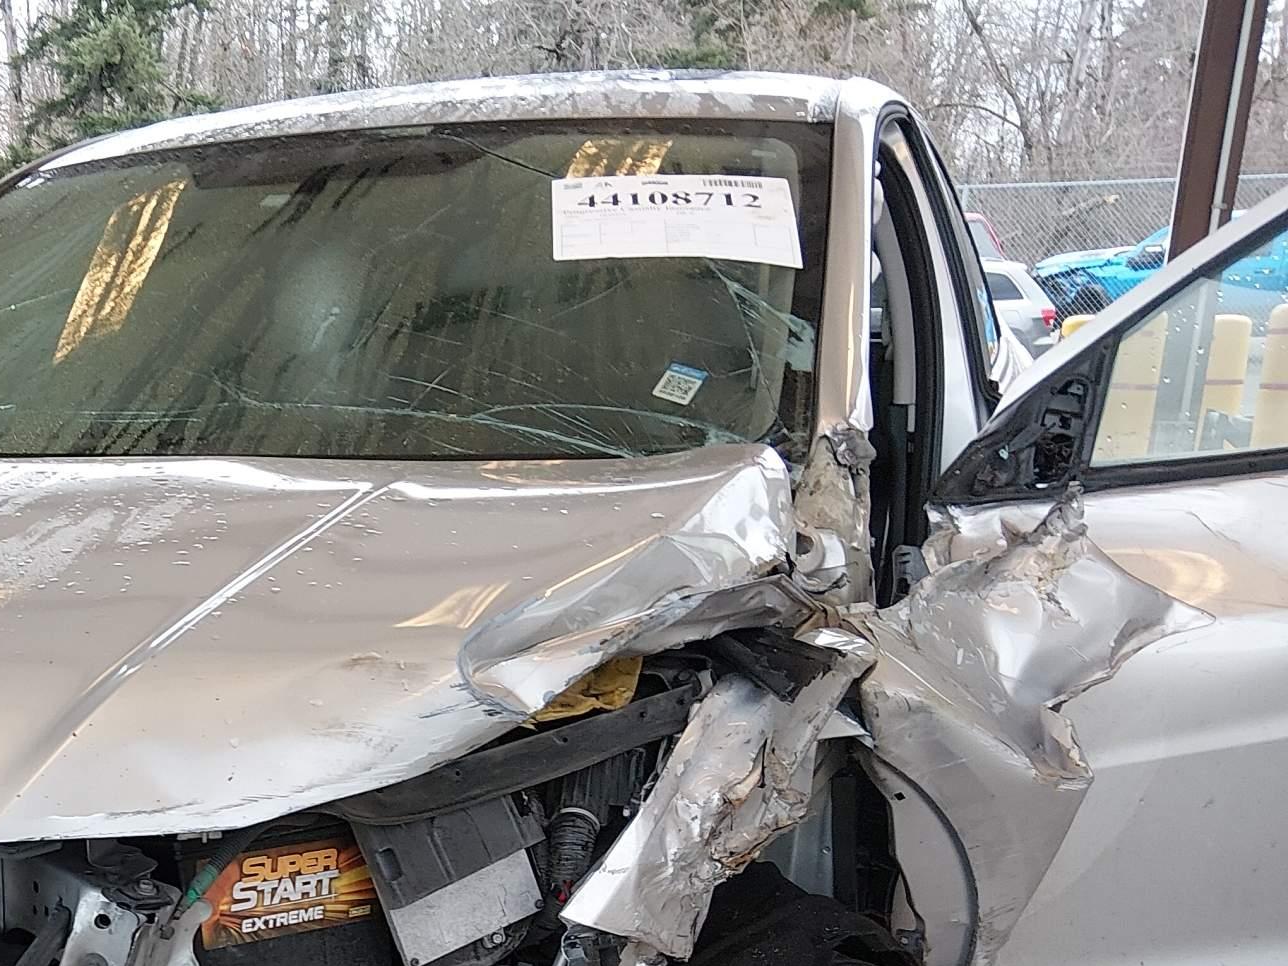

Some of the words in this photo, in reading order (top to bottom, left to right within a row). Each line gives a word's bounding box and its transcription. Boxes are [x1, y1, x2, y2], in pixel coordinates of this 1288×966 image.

[577, 191, 762, 209] 44108712
[242, 848, 338, 882] SUPER
[231, 870, 341, 912] START
[241, 905, 326, 934] EXTREME
